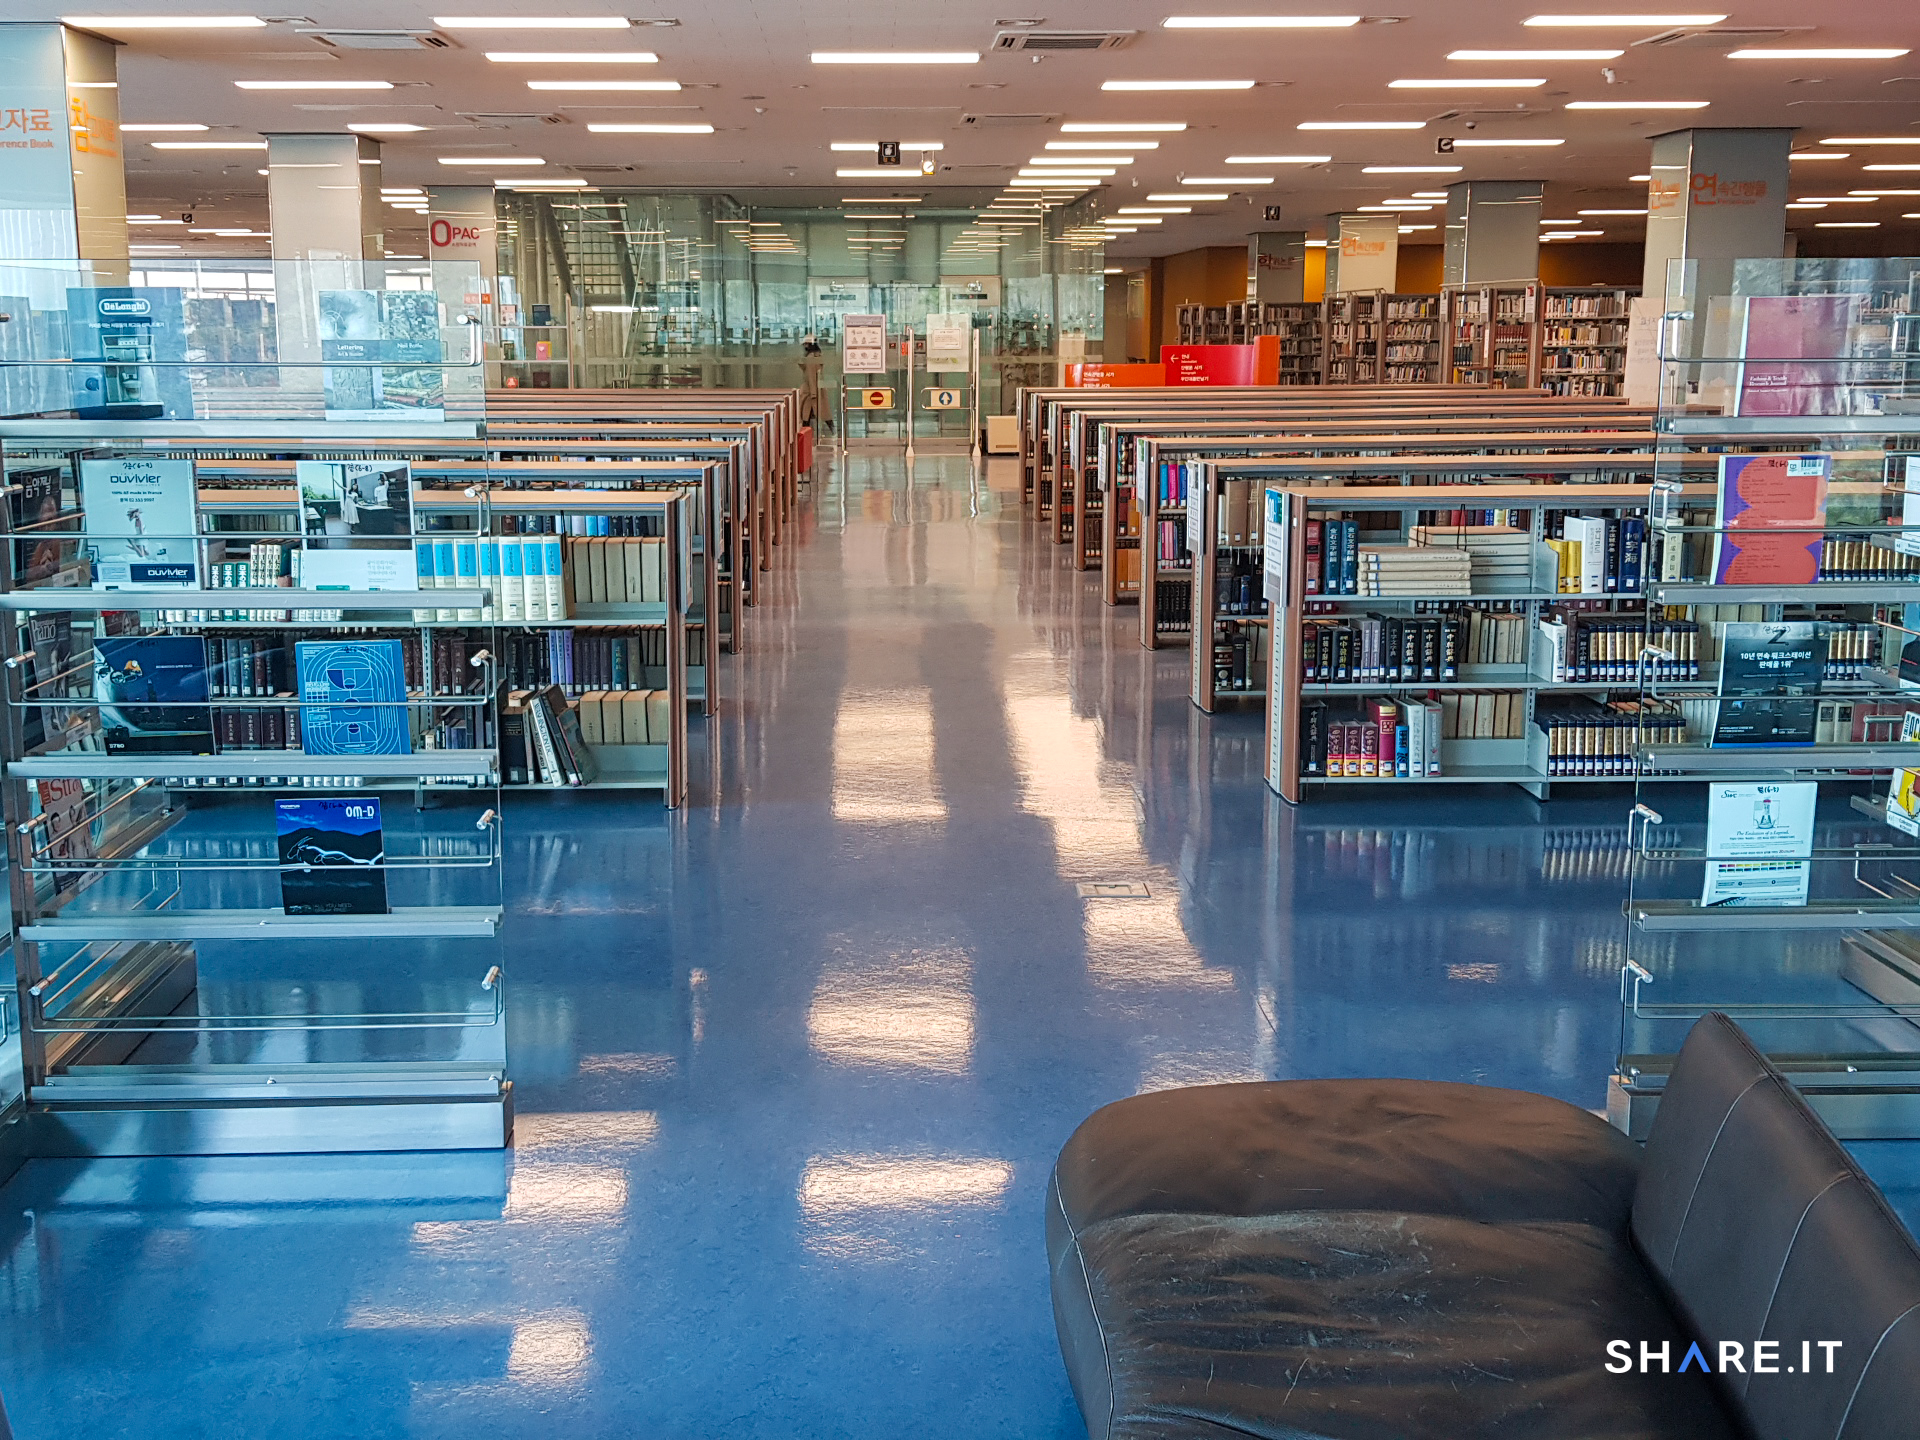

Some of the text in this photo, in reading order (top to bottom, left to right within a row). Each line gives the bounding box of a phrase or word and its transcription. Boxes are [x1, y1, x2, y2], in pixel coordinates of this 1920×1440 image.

[431, 219, 480, 247] OPAC
[31, 620, 56, 641] Piano
[346, 806, 375, 818] OM-D
